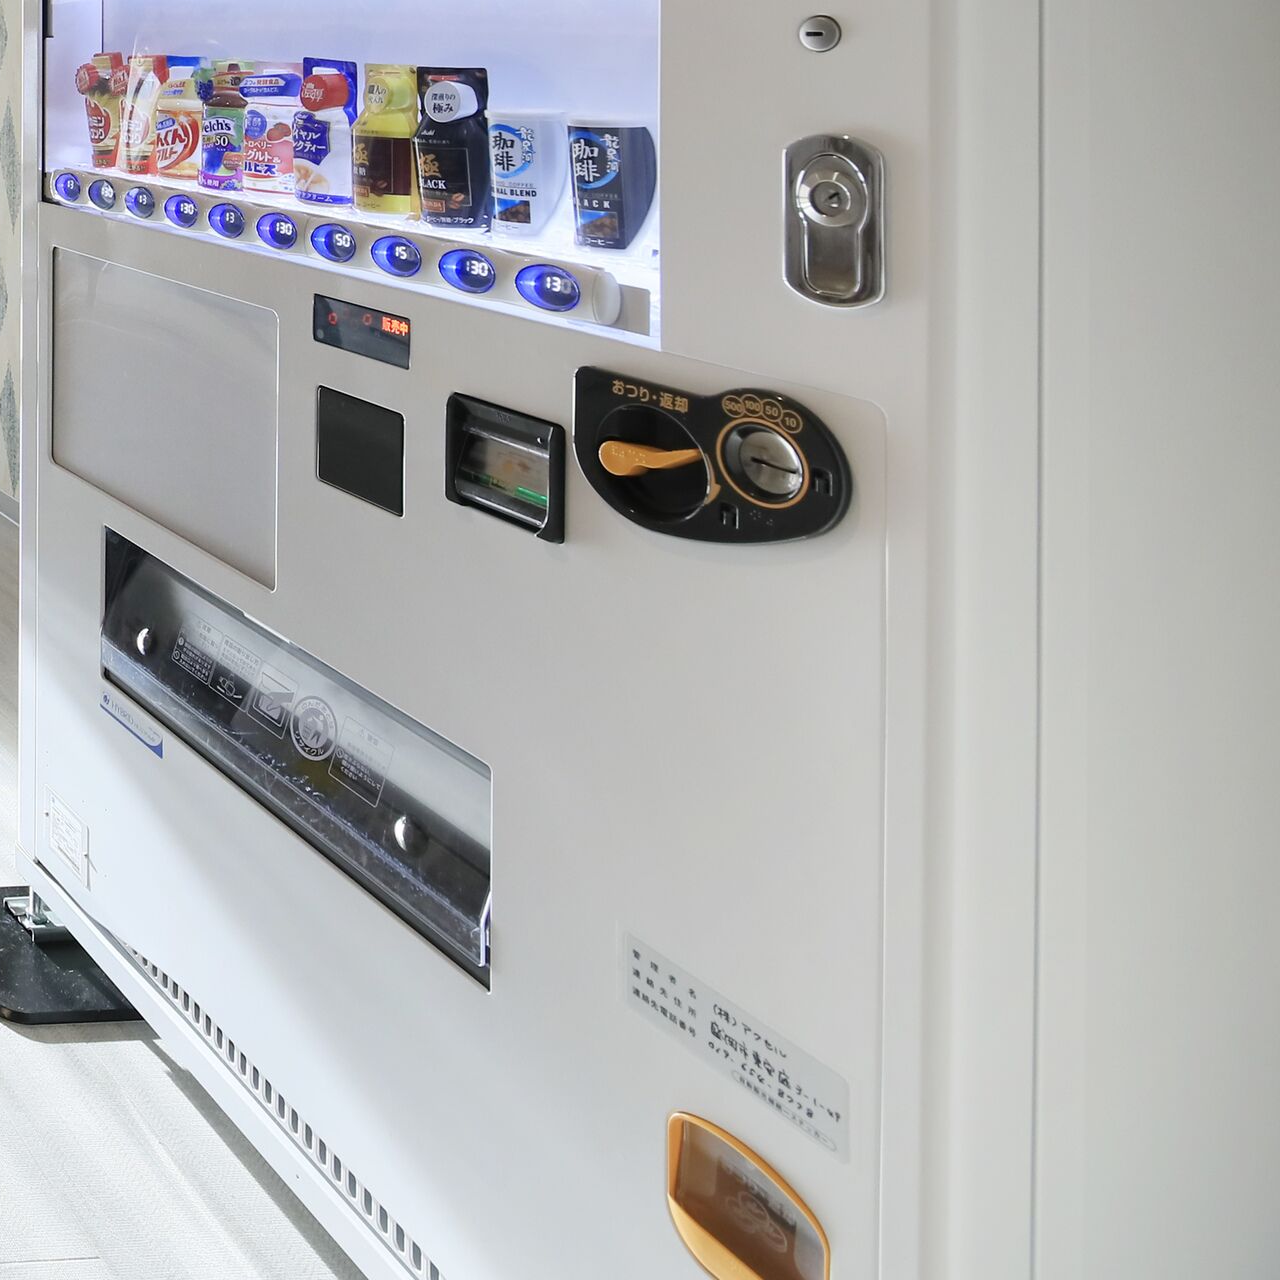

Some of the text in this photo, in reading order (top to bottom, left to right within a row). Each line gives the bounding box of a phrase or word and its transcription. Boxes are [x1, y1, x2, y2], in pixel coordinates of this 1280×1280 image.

[180, 202, 195, 215] 130
[276, 220, 293, 235] 130
[382, 316, 409, 336] 販売中
[612, 379, 689, 413] おつり・返却
[725, 399, 797, 428] 500 100 50 10
